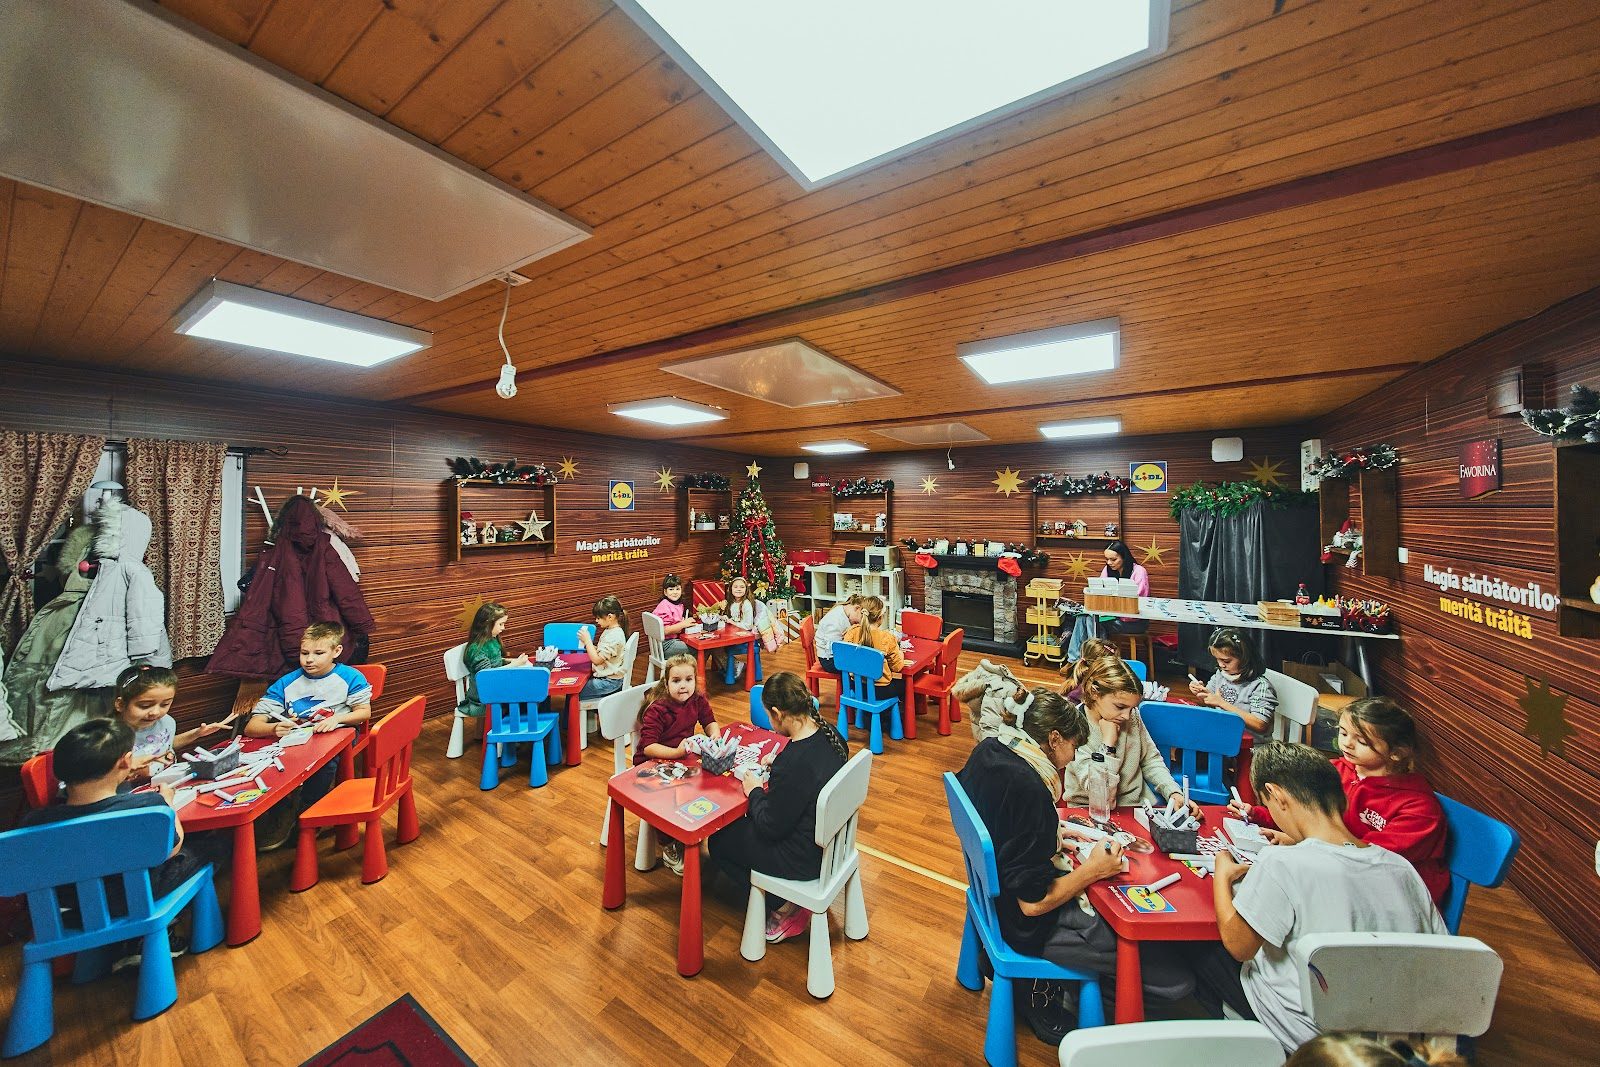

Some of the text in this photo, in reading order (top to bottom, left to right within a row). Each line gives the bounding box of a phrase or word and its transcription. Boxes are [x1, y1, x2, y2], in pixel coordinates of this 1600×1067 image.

[1460, 464, 1497, 478] FAVORINA
[576, 536, 661, 552] Magia sărbătorilor
[592, 549, 648, 563] merită trăită
[1423, 564, 1460, 591] Magia
[1439, 596, 1533, 640] merită trăită
